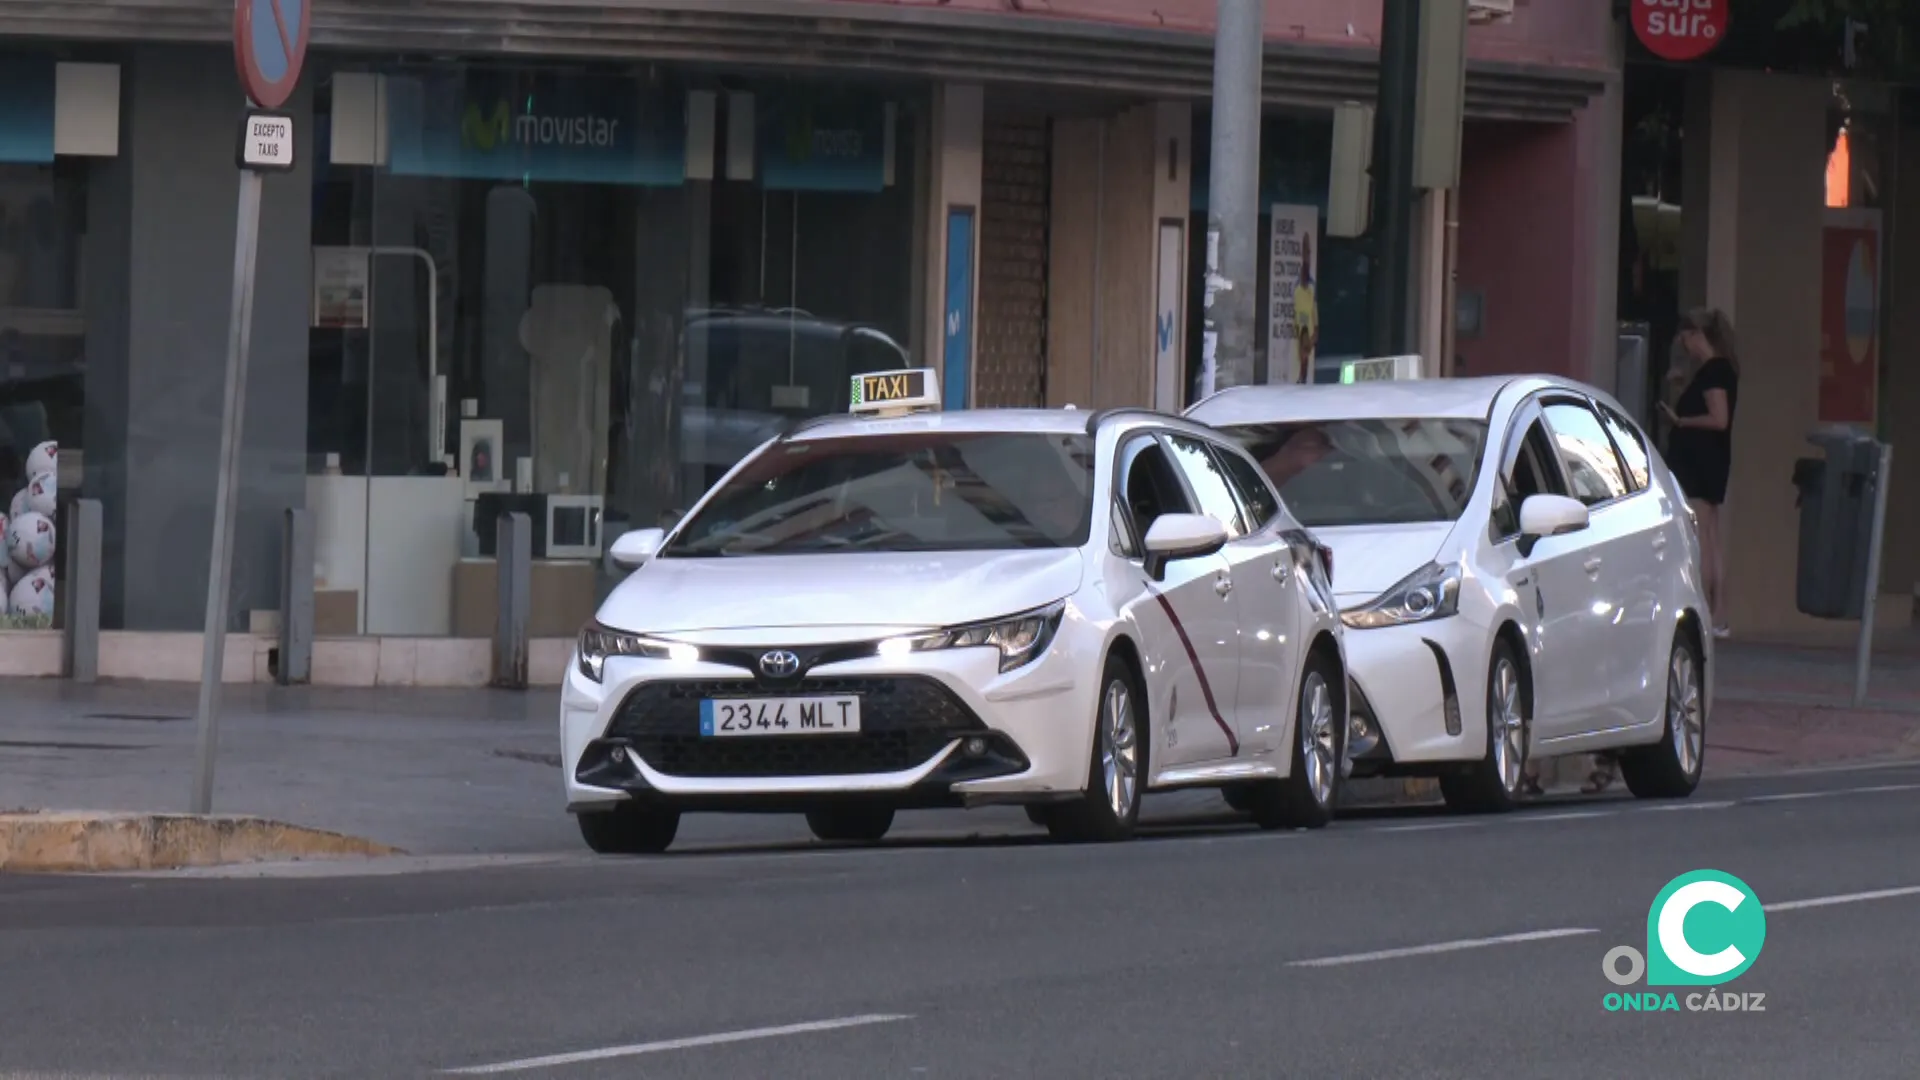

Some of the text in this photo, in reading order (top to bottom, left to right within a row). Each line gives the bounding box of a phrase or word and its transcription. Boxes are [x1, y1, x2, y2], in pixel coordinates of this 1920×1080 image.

[253, 123, 285, 138] EXCEPTO
[515, 114, 618, 146] movistar
[258, 143, 279, 156] TAXIS
[865, 375, 907, 400] TAXI
[720, 701, 852, 731] 2344 MLT
